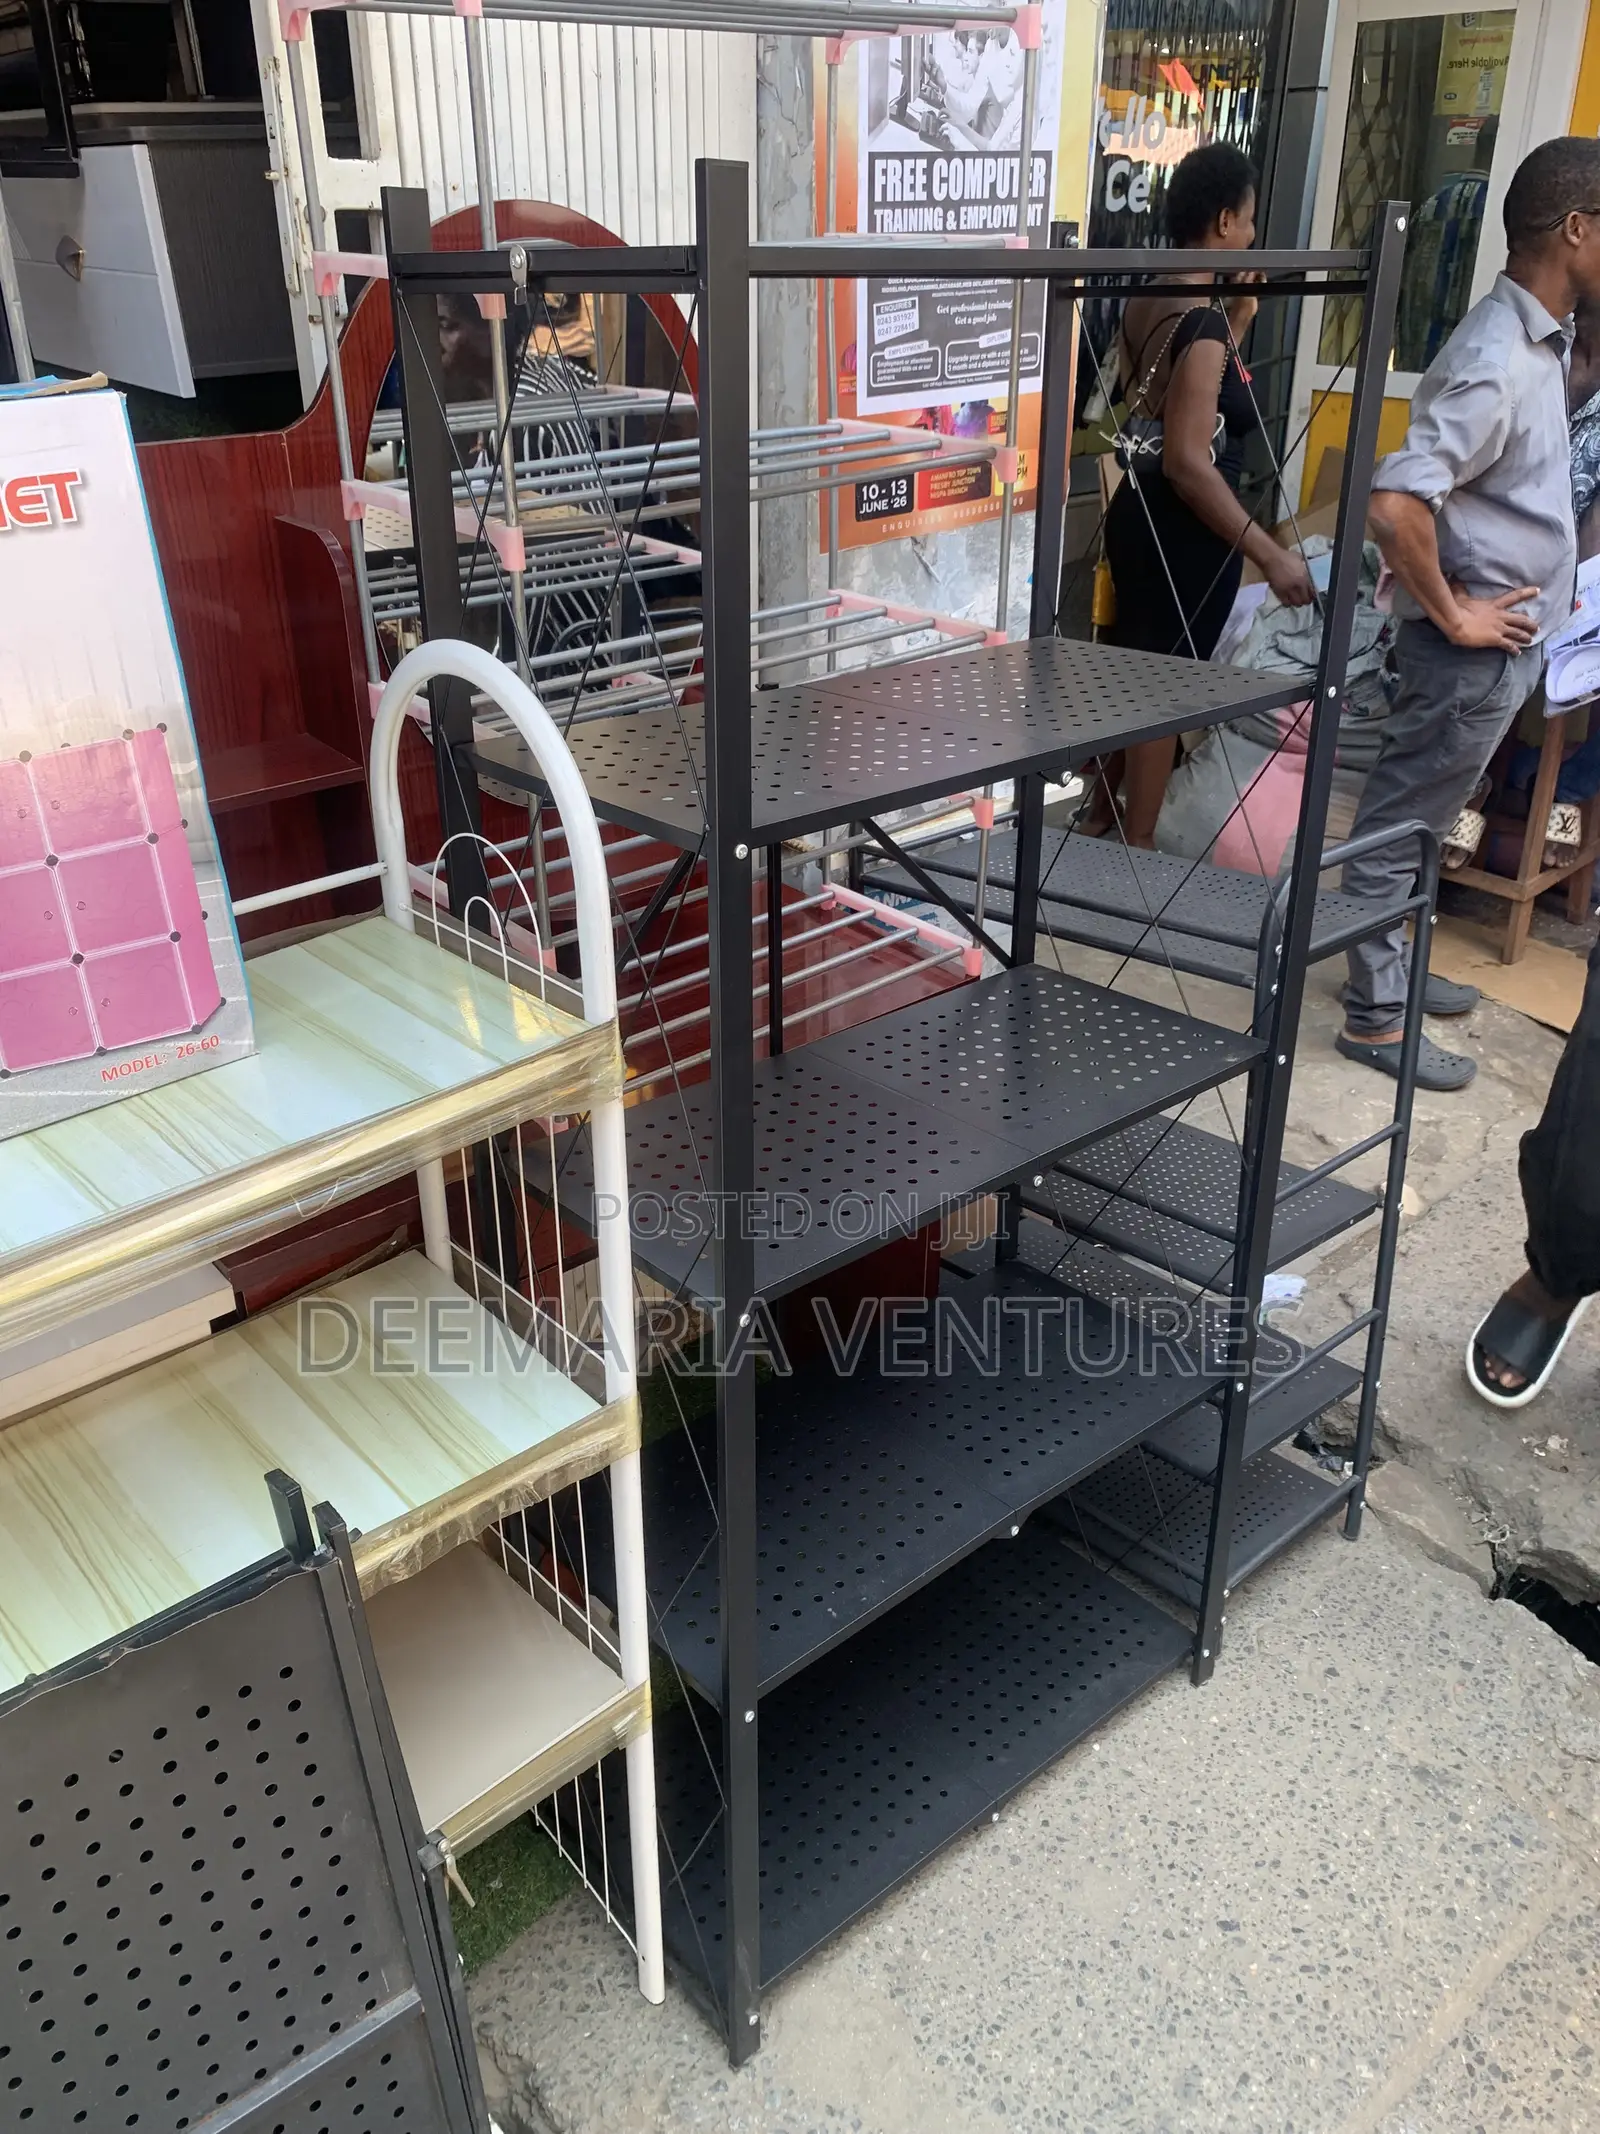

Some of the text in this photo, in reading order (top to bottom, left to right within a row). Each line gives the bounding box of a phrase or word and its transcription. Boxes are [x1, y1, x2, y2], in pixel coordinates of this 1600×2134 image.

[874, 158, 927, 202] FREE
[874, 204, 1043, 233] TRAINING & EMPLOYMNT
[880, 301, 912, 314] ENQUIRIES
[937, 305, 949, 314] Get
[950, 301, 987, 316] professional
[955, 316, 966, 325] Get
[973, 314, 986, 325] good
[986, 313, 997, 324] job
[0, 471, 81, 529] ET
[861, 483, 879, 501] 10
[890, 479, 907, 497] 13
[859, 498, 889, 515] JUNE
[101, 1034, 220, 1083] MODEL: 26-60
